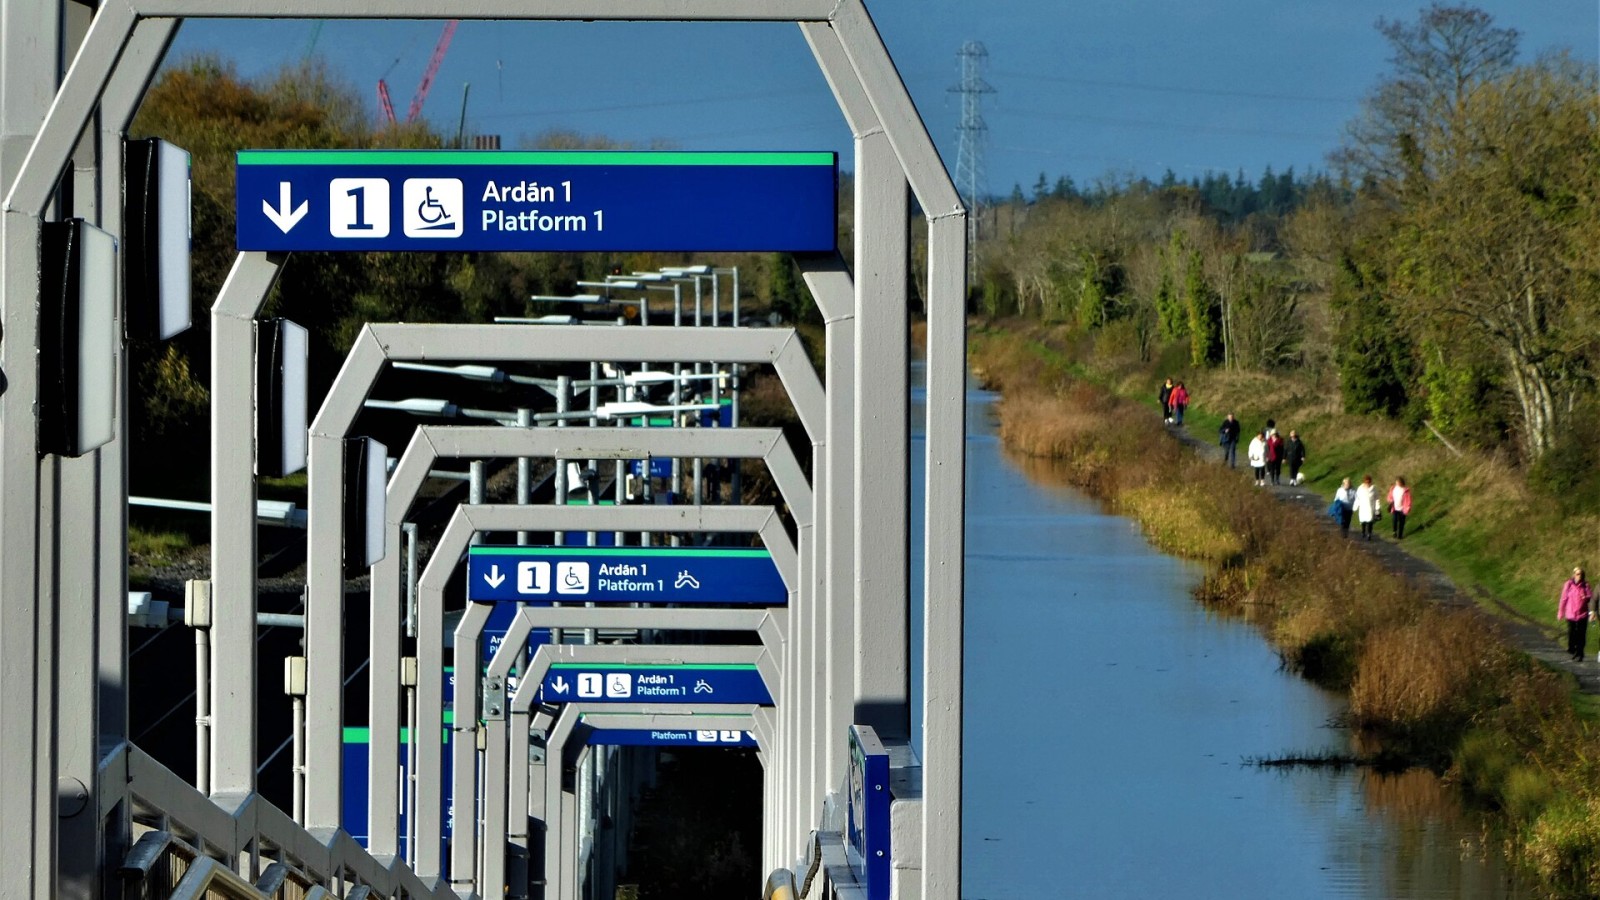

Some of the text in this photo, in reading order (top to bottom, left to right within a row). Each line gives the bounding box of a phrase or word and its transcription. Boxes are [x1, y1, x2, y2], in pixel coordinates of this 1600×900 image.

[481, 180, 571, 203] Ardán 1
[346, 186, 374, 230] 1
[481, 209, 603, 232] Platform 1
[598, 563, 647, 576] Ardán 1
[527, 566, 541, 590] 1
[598, 578, 664, 592] Platform 1
[585, 677, 595, 694] 1
[637, 674, 674, 684] Ardán 1
[637, 685, 686, 696] Platform 1
[651, 731, 693, 740] Platform 1
